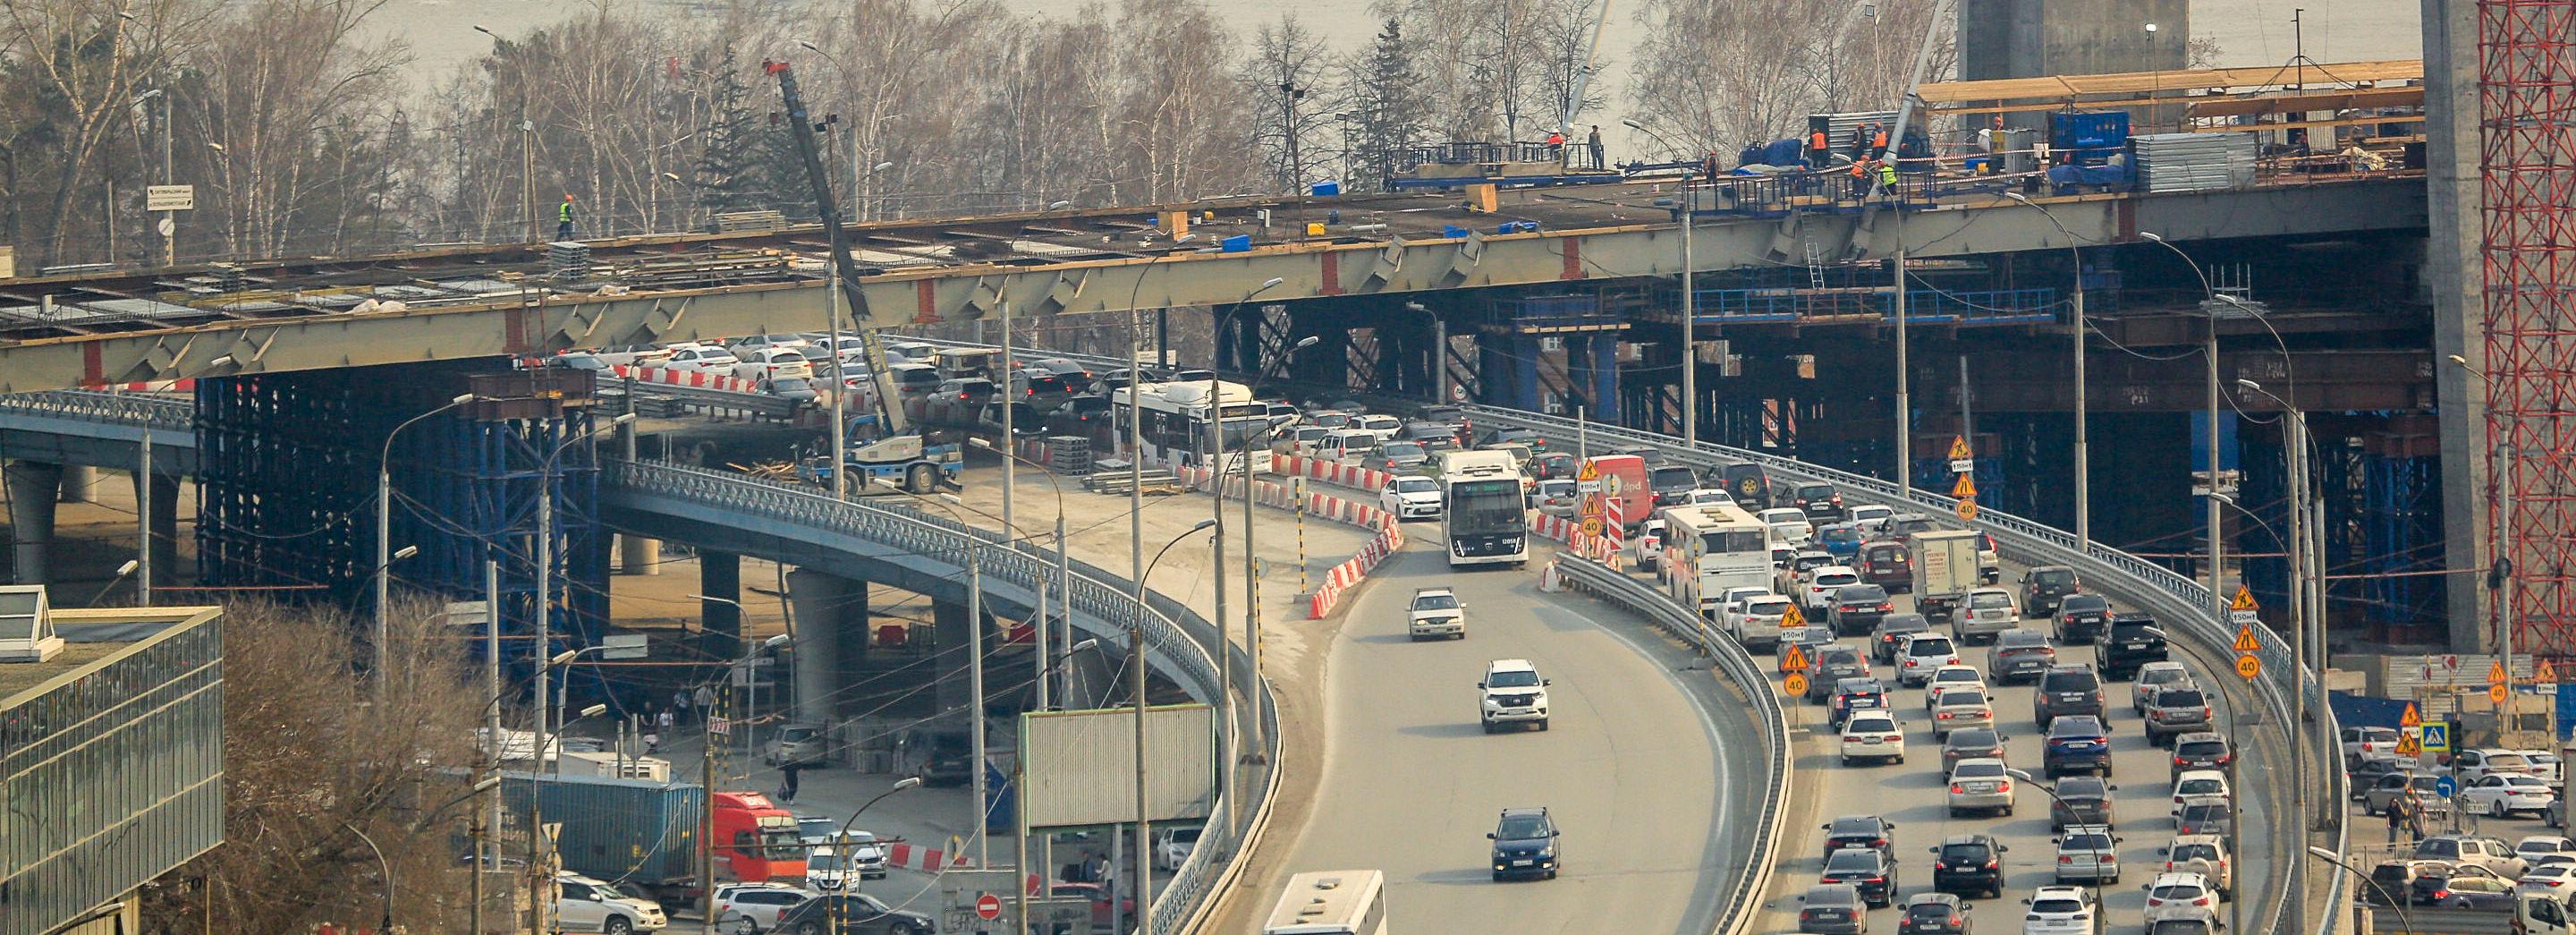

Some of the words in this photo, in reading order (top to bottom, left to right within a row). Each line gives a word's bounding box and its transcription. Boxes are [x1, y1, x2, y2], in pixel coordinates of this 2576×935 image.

[1623, 481, 1641, 492] dpd
[1962, 505, 1973, 514] 40
[1586, 523, 1597, 531] 40
[2241, 661, 2255, 672] 40
[1789, 680, 1802, 690] 40
